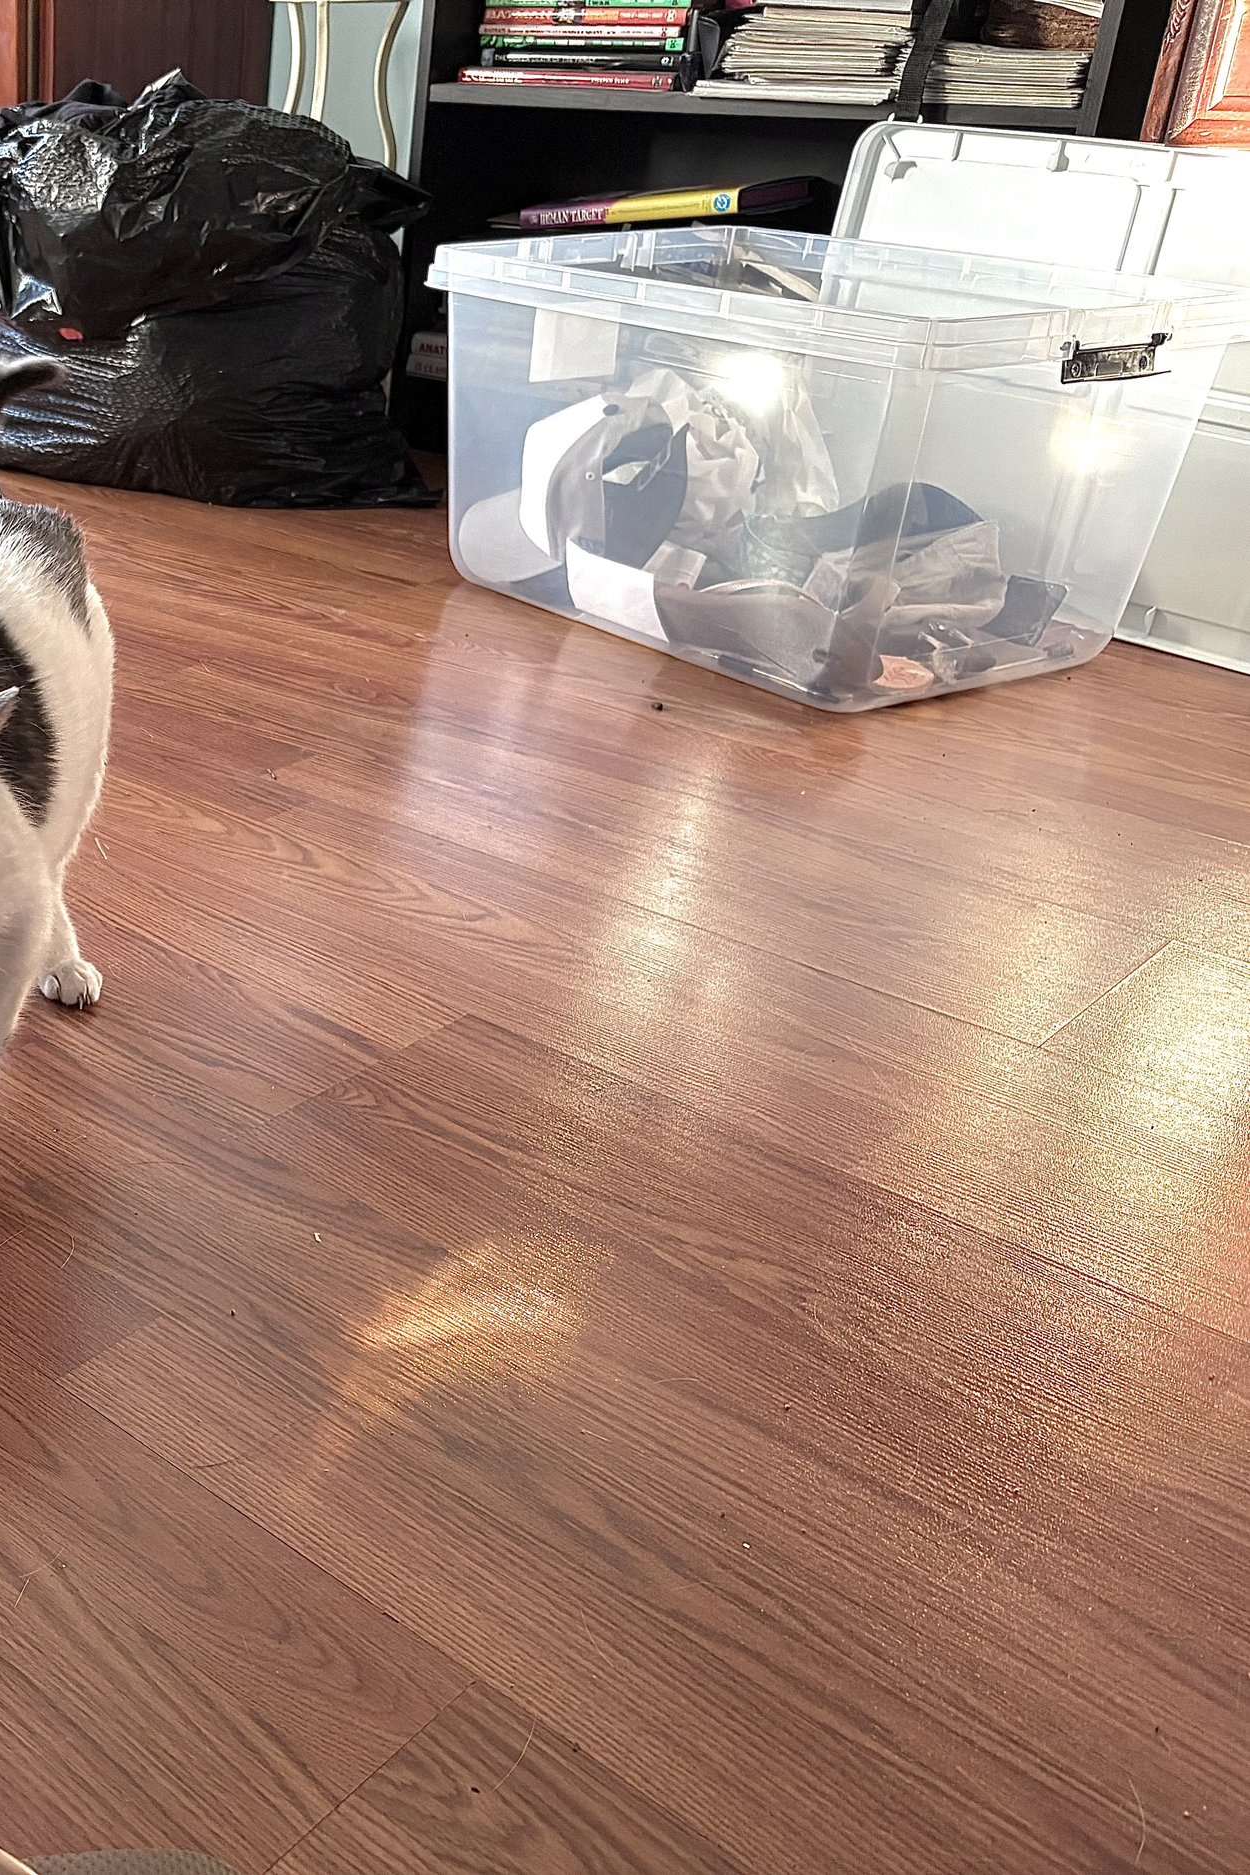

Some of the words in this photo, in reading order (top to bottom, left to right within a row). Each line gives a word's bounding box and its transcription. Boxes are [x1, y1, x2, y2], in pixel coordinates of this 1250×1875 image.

[539, 210, 569, 226] HUMAN
[569, 207, 604, 223] TARGET
[419, 342, 448, 355] ANAT
